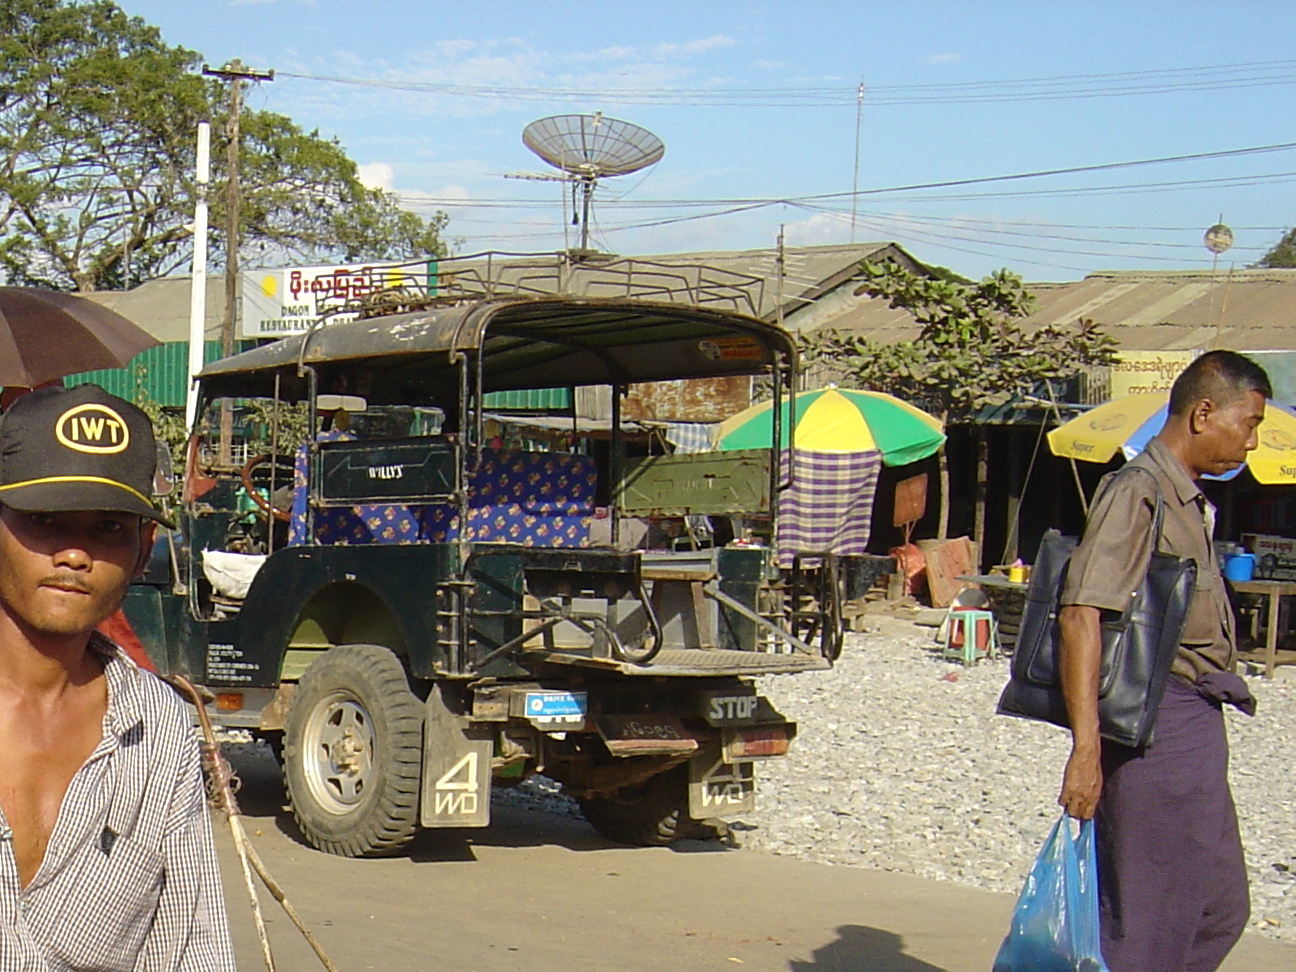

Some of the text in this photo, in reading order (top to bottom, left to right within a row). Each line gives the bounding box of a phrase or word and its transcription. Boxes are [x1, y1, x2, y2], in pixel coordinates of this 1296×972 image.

[281, 304, 310, 317] DAGON
[260, 319, 317, 332] RESTAURANT
[71, 416, 120, 443] IWT
[709, 696, 757, 719] STOP
[435, 752, 478, 792] 4
